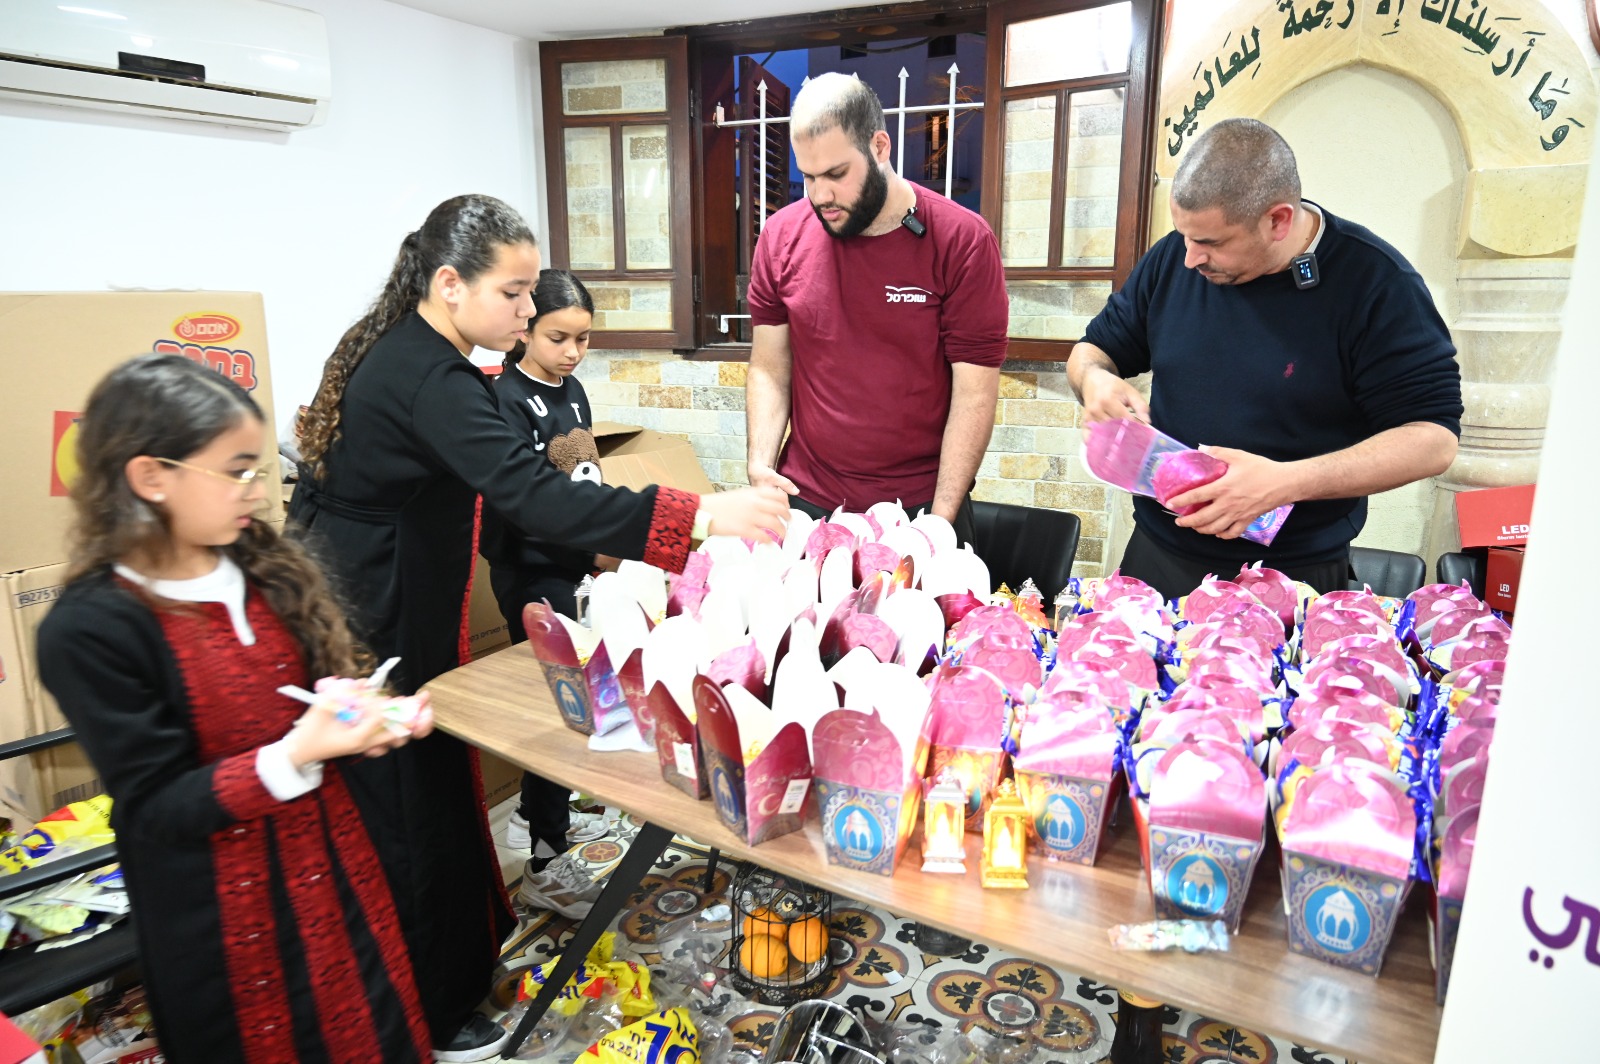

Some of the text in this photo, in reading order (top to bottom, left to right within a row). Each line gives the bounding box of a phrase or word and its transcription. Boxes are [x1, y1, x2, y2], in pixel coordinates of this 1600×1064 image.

[886, 292, 926, 303] שופרסל
[196, 323, 229, 336] אסם
[1501, 524, 1529, 534] LED
[1499, 583, 1509, 592] LED
[617, 1041, 632, 1057] 25
